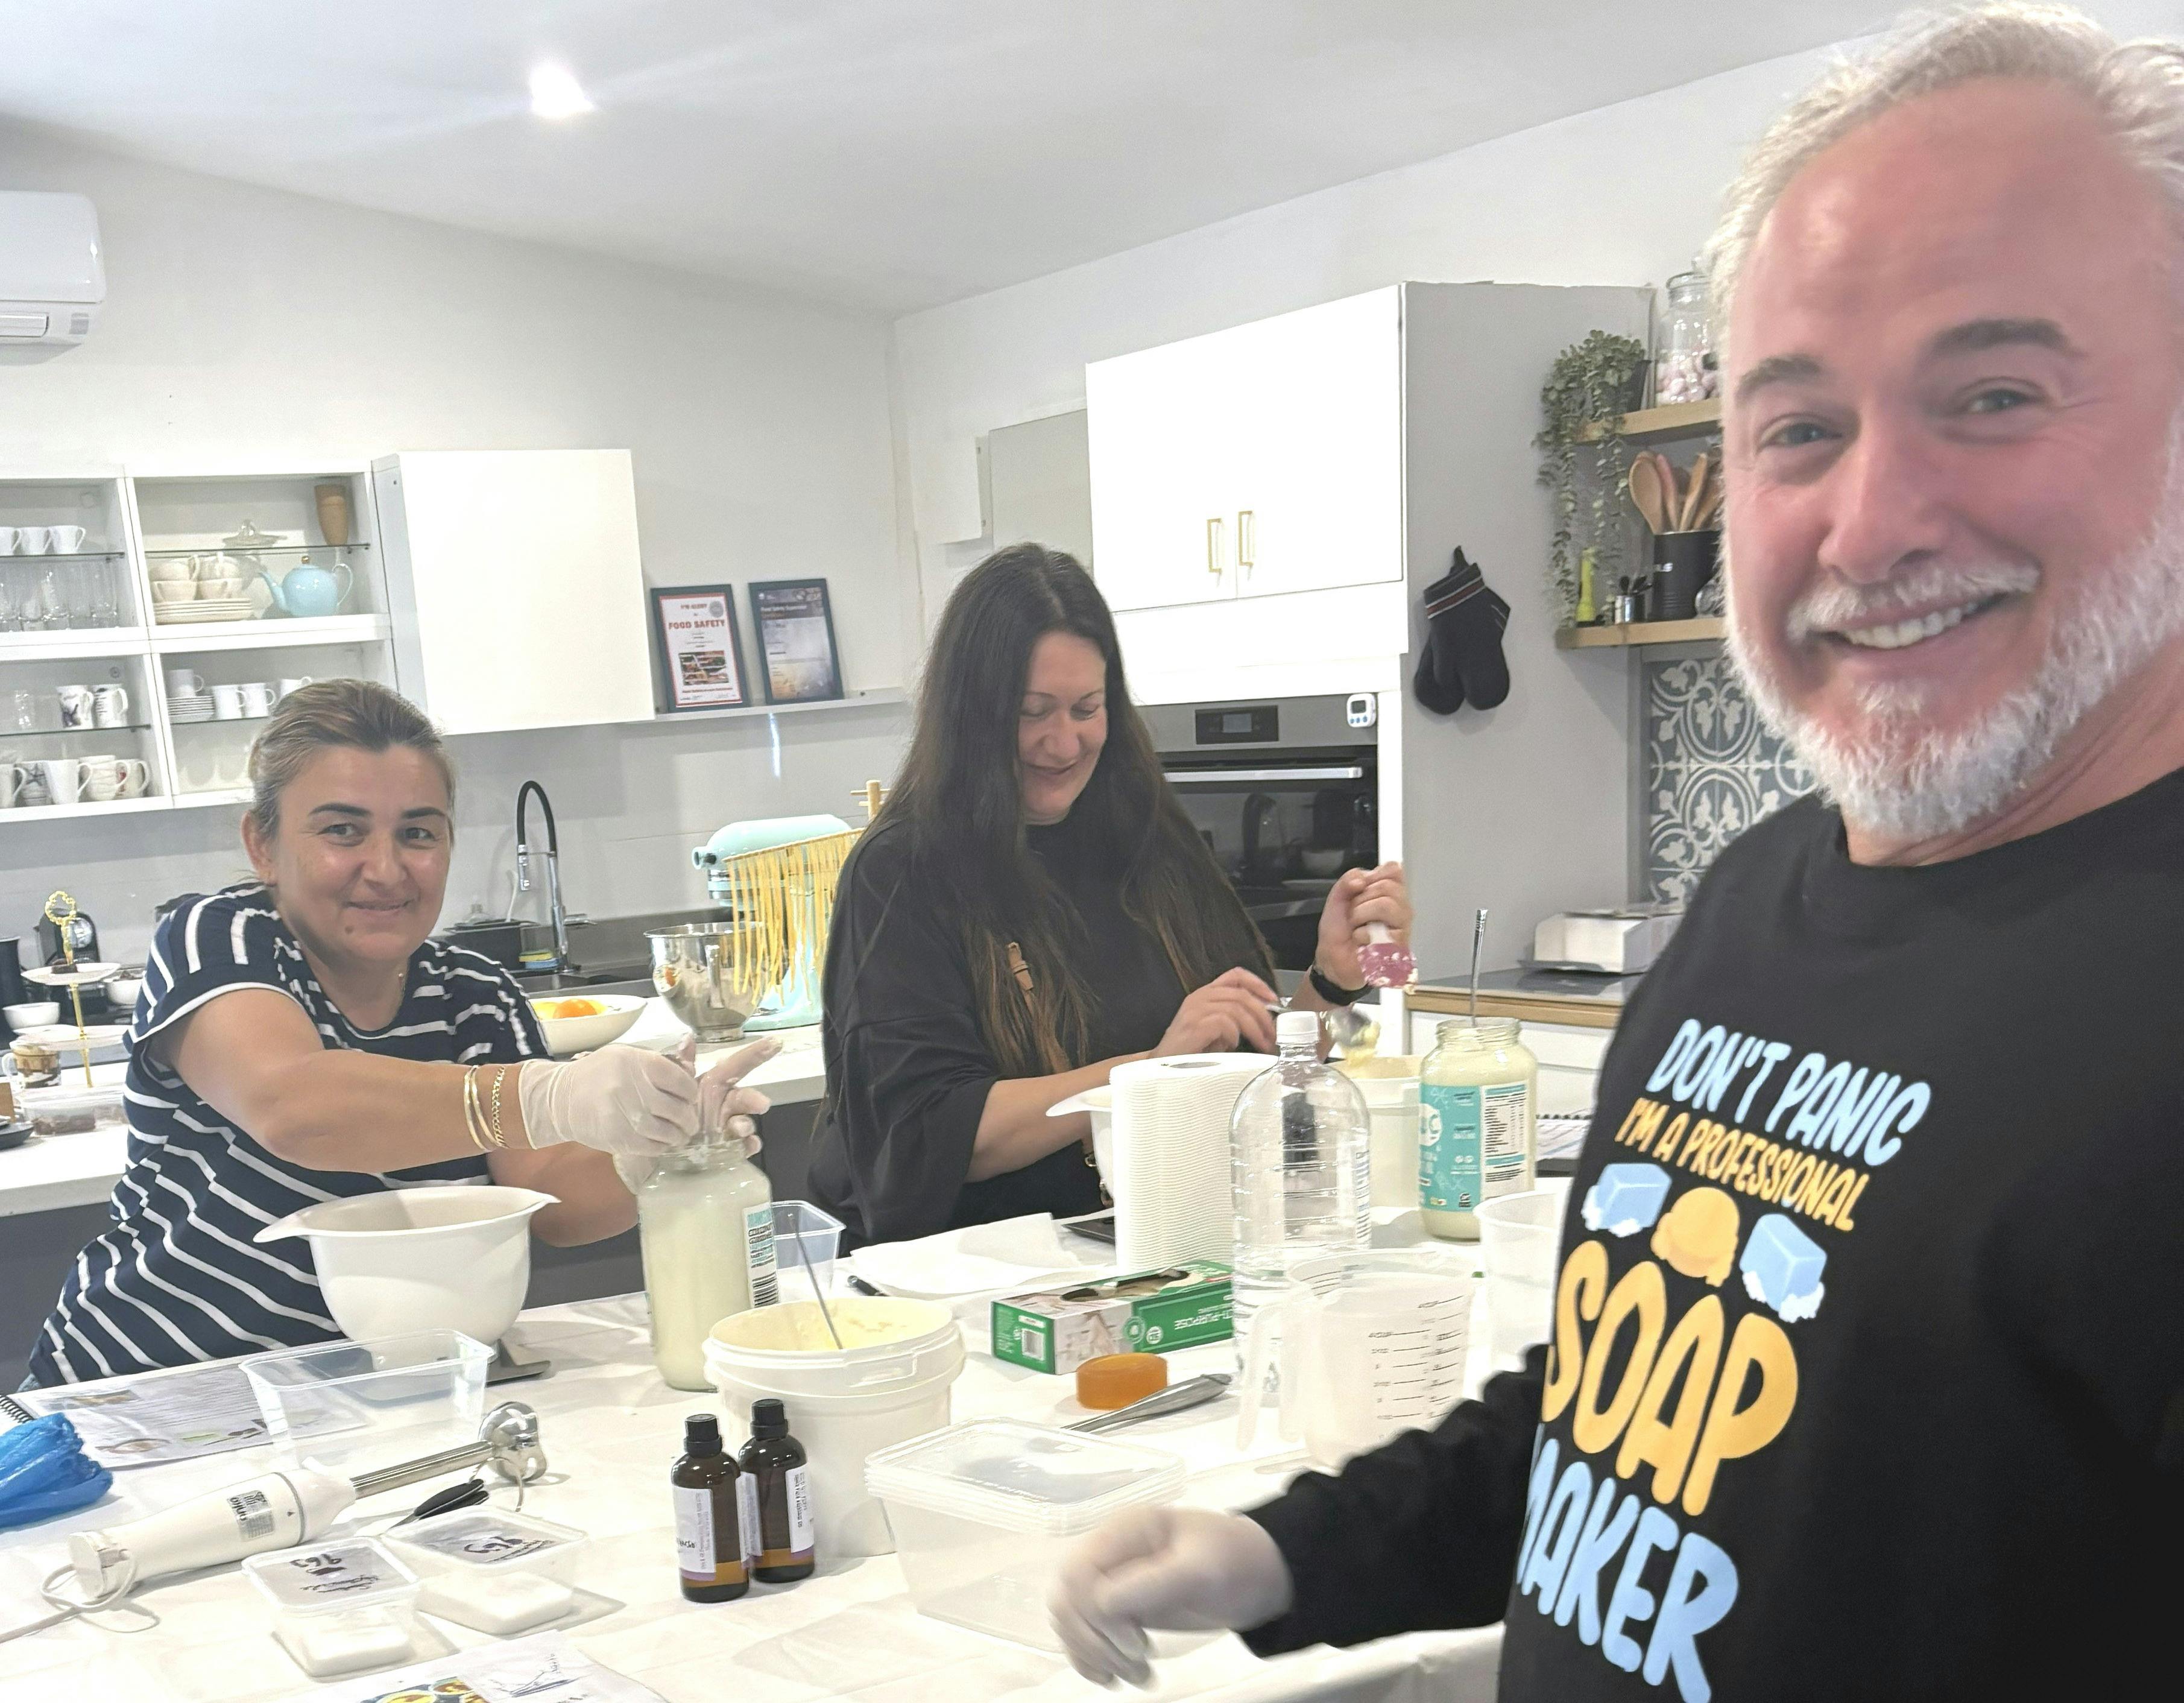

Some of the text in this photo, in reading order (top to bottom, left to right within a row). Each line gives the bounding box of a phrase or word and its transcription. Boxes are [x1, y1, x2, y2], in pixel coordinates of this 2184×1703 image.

[668, 619, 725, 630] FOOD SAFETY
[1645, 1018, 1792, 1124] DON'T
[1764, 1052, 1931, 1166] PANIC
[1614, 1097, 1870, 1232] I'M A PROFESSIONAL
[1541, 1239, 1799, 1517] SOAP
